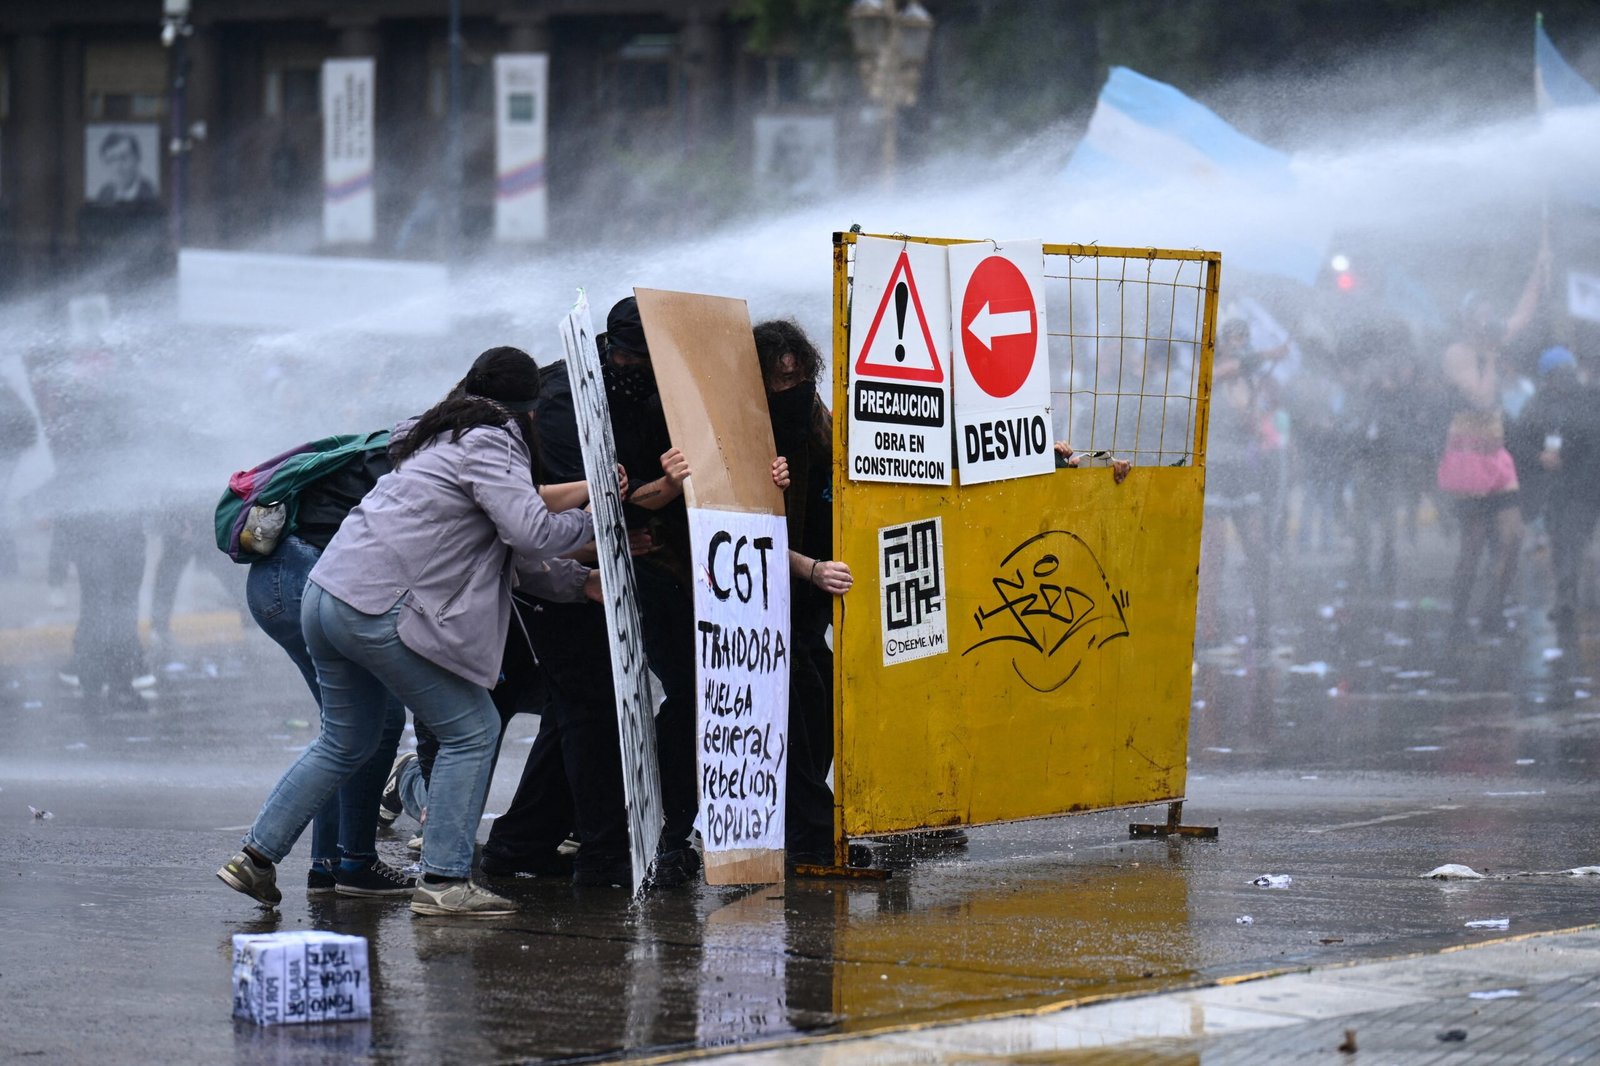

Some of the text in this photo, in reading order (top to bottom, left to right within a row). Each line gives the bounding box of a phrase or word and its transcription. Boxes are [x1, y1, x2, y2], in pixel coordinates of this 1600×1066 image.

[859, 389, 940, 419] PRECAUCION
[874, 431, 925, 453] OBRA EN
[964, 415, 1047, 464] DESVIO
[854, 455, 945, 480] CONSTRUCCION
[698, 620, 787, 675] TRAIDORA
[704, 677, 752, 719] HUELGA
[310, 993, 355, 1014] FONDO
